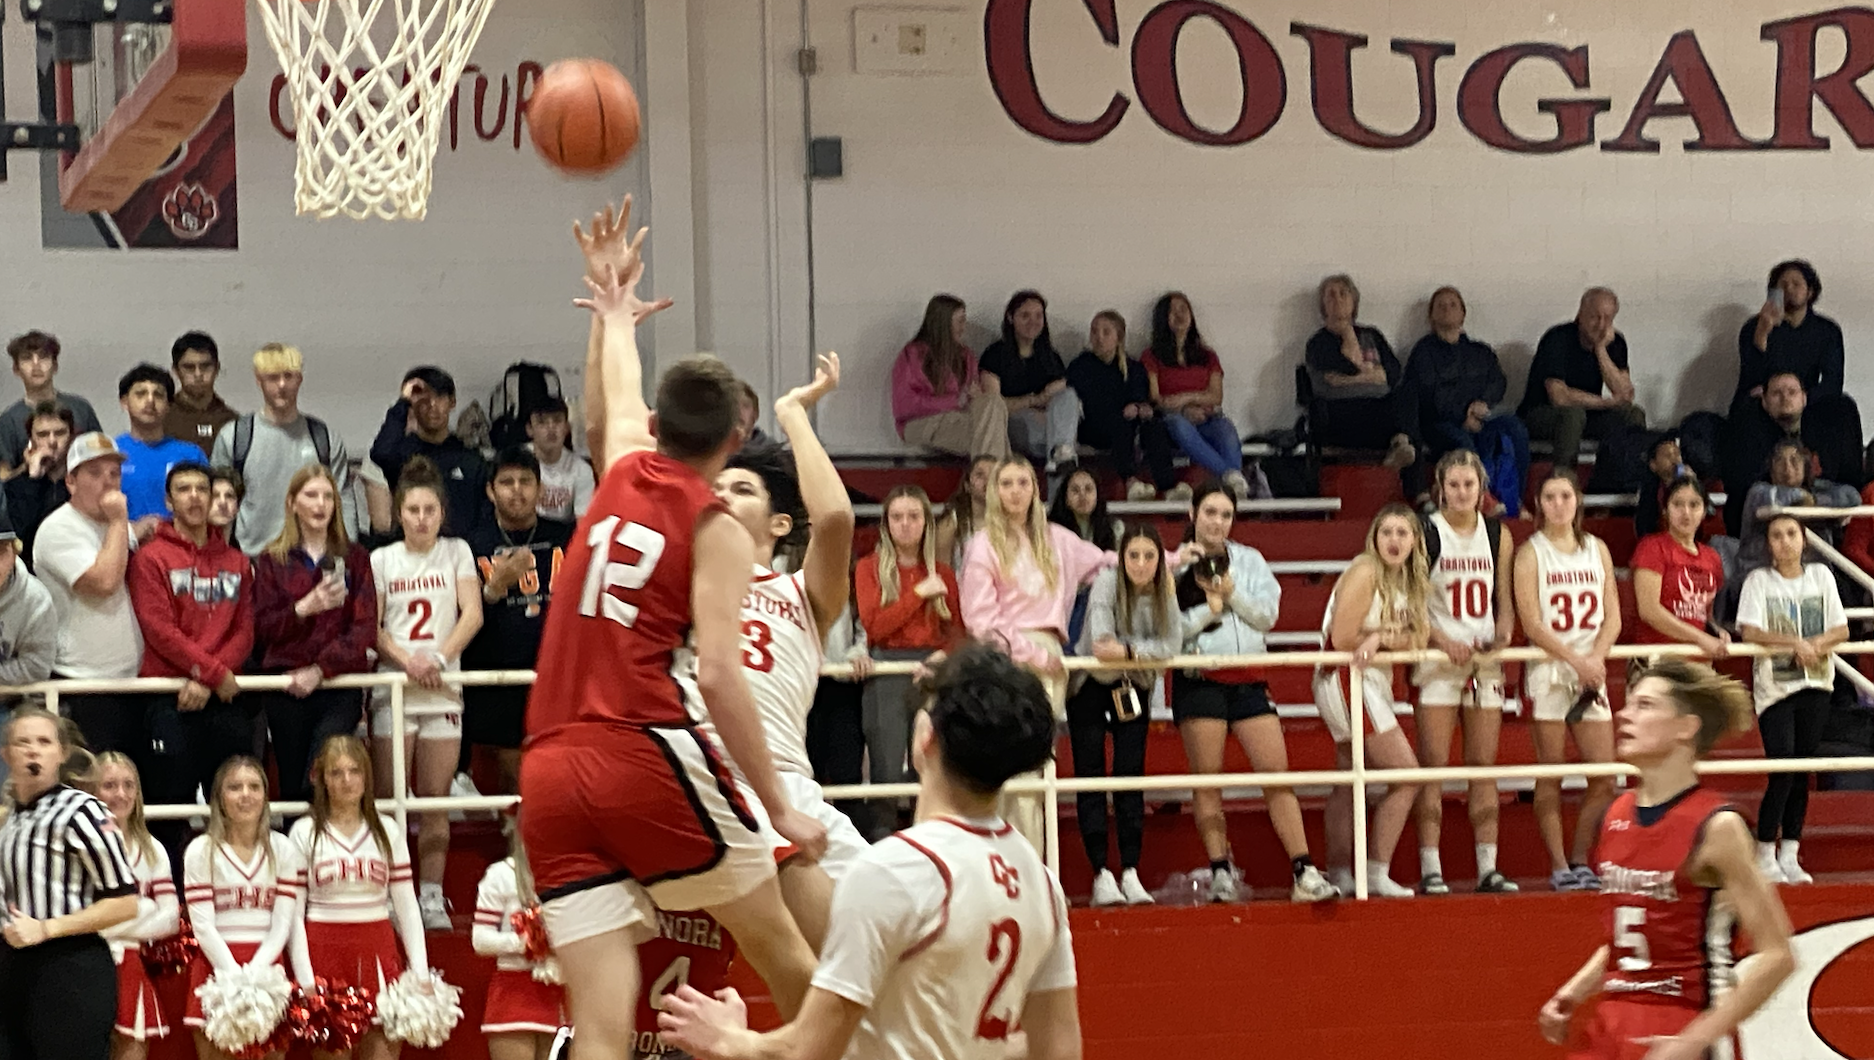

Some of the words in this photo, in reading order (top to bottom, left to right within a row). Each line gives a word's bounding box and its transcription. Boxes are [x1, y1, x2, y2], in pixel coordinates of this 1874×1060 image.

[984, 0, 1874, 153] COUGAR
[578, 514, 666, 628] 12
[1439, 557, 1492, 572] CHRISTOVAL
[1546, 570, 1598, 586] CHRISTOVAL
[407, 597, 434, 641] 2
[1446, 578, 1488, 621] 10
[1550, 591, 1598, 632] 32
[741, 619, 775, 674] 3
[314, 857, 390, 888] CHS
[655, 911, 722, 951] NORA
[1613, 906, 1653, 972] 5
[976, 917, 1022, 1041] 2
